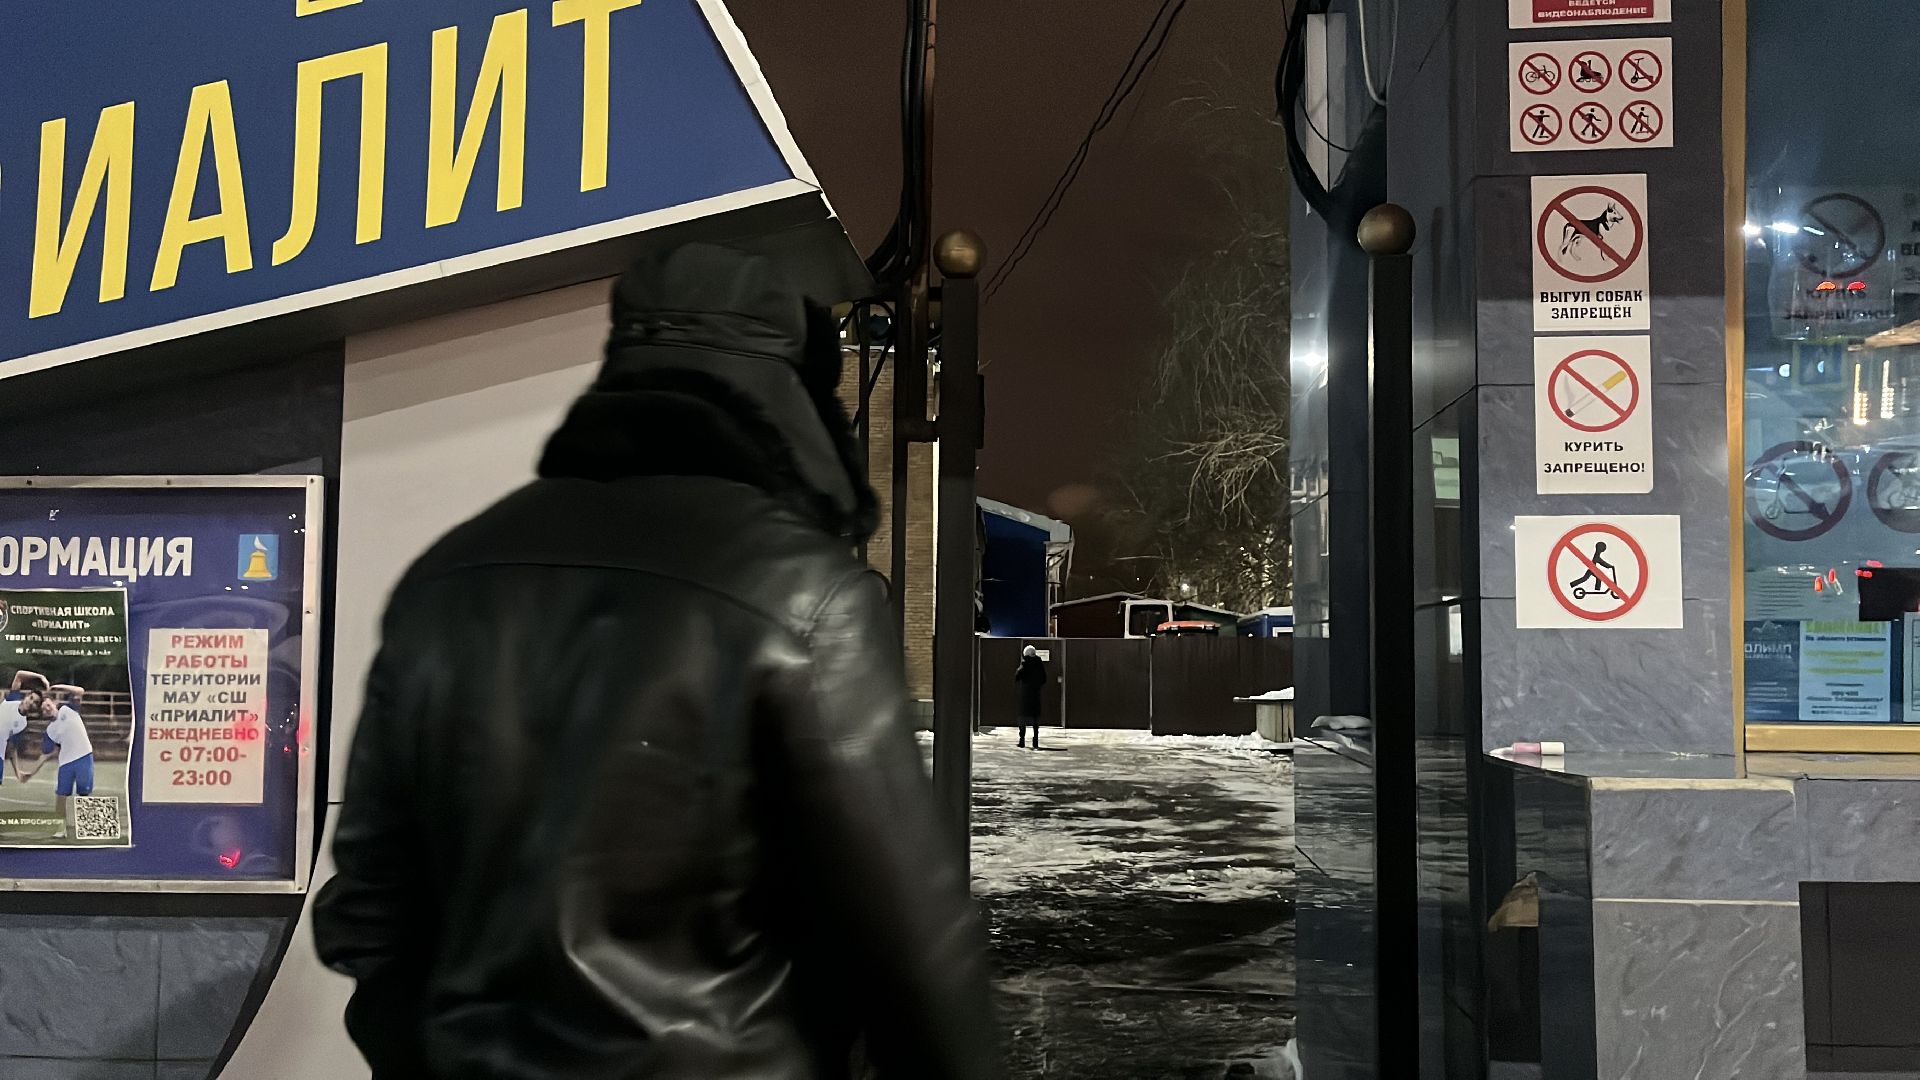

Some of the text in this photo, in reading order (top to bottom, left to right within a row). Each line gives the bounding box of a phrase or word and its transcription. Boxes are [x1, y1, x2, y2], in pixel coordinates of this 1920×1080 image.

[1537, 7, 1648, 18] ВИДЕОНАБЛЮДЕНИЕ
[0, 0, 641, 318] ИАЛИТ
[1540, 290, 1643, 303] ВЫГУЛ СОБАК
[1551, 304, 1632, 320] ЗАПРЕЩЁН
[1564, 441, 1624, 452] КУРИТЬ
[1544, 462, 1645, 475] ЗАПРЕЩЕНО!
[10, 605, 72, 617] СПОРТИВНАЯ
[73, 606, 115, 616] ШКОЛА
[31, 619, 91, 630] «ПРИАЛИТ»
[171, 635, 244, 649] РЕЖИМ
[165, 655, 248, 668] РАБОТЫ
[151, 673, 261, 685] ТЕРРИТОРИИ
[163, 691, 247, 704] МАУ «СШ
[150, 709, 259, 722] «ПРИАЛИТ»
[148, 728, 259, 742] ЕЖЕДНЕВНО
[180, 746, 247, 762] 07:00-
[172, 769, 232, 786] 23:00
